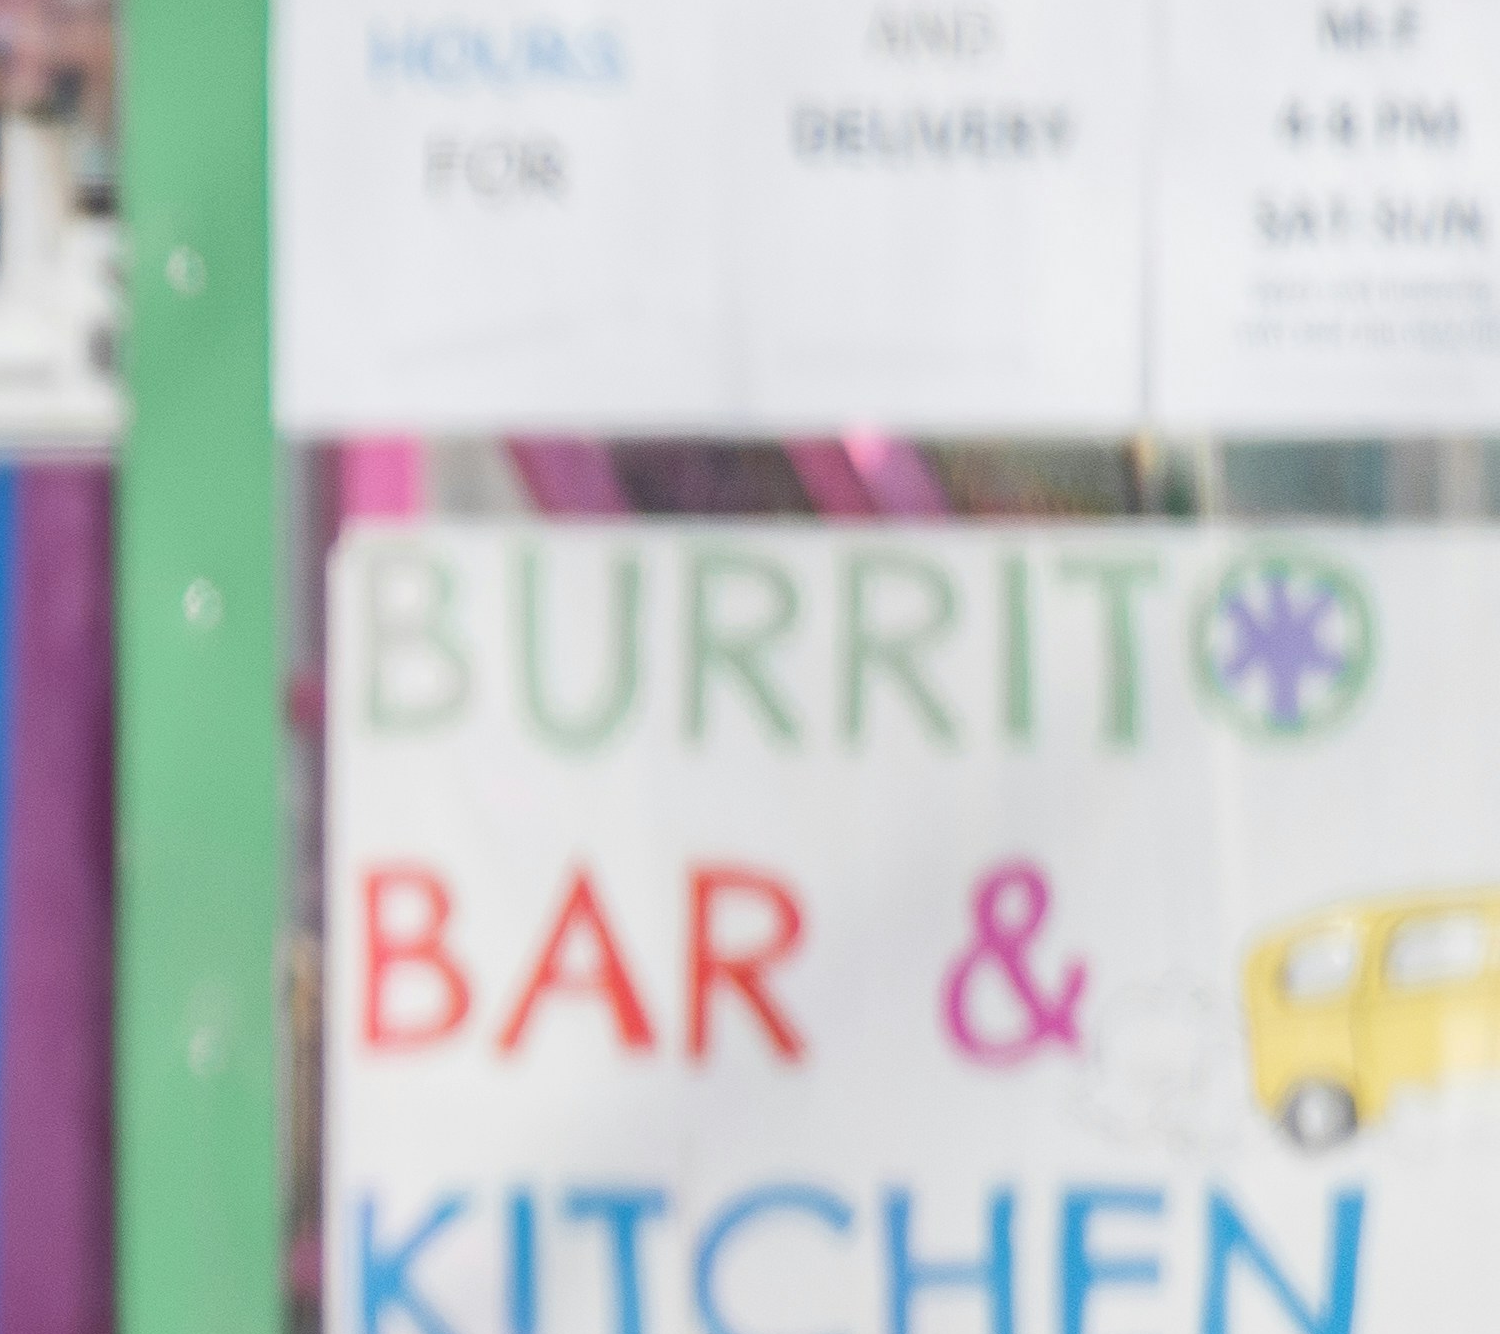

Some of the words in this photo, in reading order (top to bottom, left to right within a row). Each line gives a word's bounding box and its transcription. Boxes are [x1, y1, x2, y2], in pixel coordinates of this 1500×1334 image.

[368, 25, 625, 91] HOURS
[867, 8, 1000, 61] AND
[792, 104, 1074, 162] DELIVERY
[1375, 100, 1460, 146] PM
[423, 137, 564, 203] FOR
[354, 533, 1378, 753] BURRITO
[357, 859, 809, 1062] BAR
[939, 859, 1089, 1065] &
